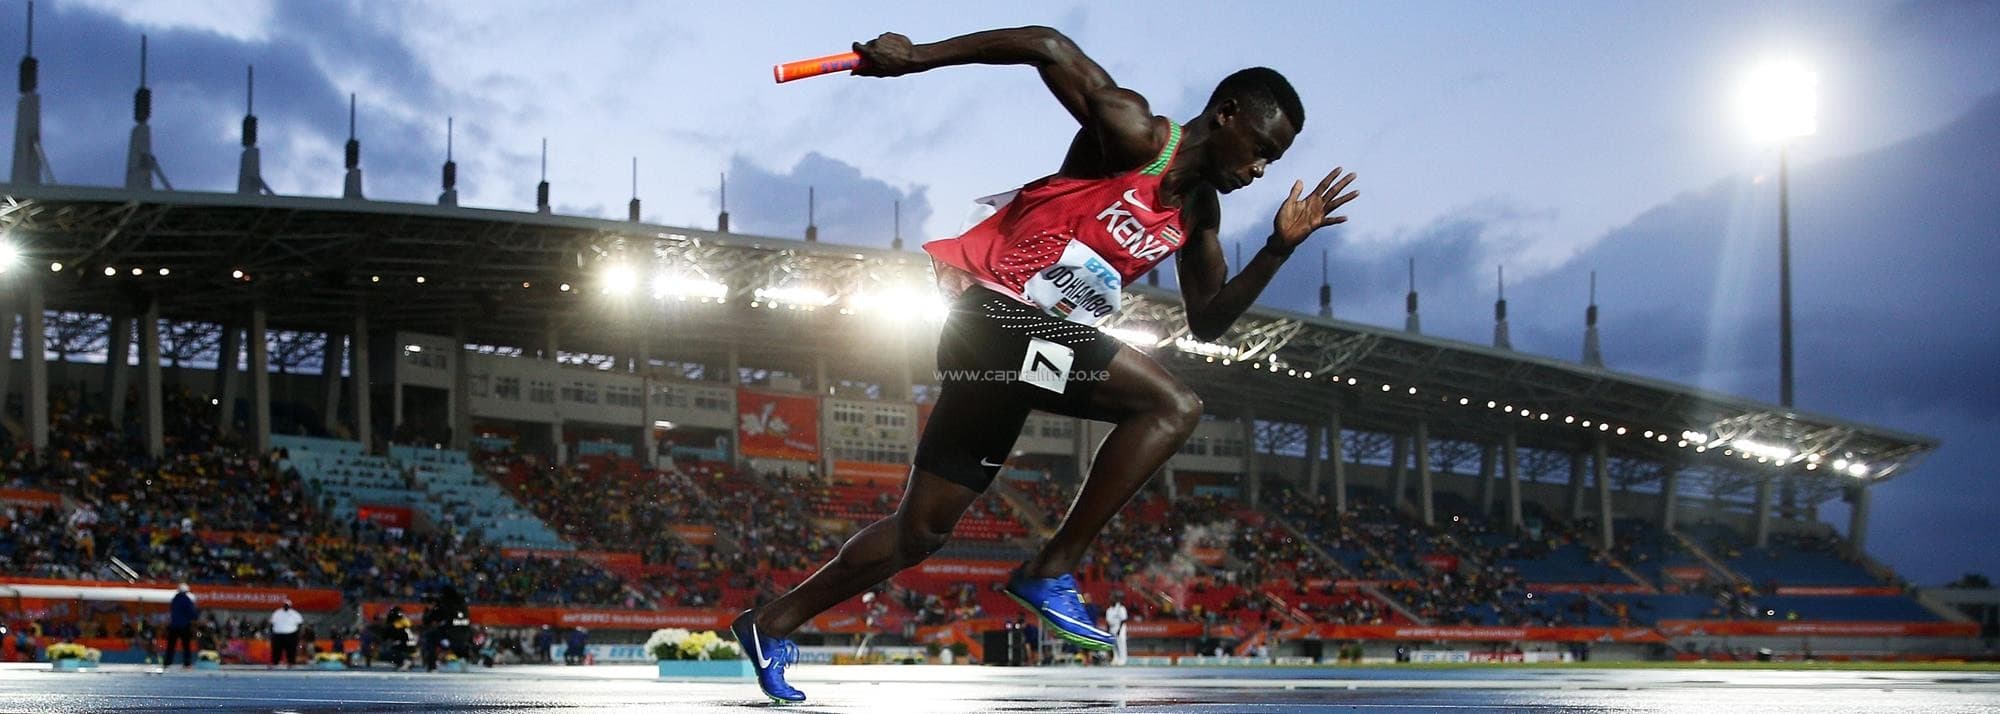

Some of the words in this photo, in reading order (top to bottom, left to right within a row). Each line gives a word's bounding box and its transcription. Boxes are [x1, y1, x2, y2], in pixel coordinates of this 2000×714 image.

[1096, 201, 1169, 260] KENYA
[1045, 266, 1113, 318] ODHIAMBO
[1084, 257, 1119, 290] BTC
[1031, 351, 1062, 378] 7
